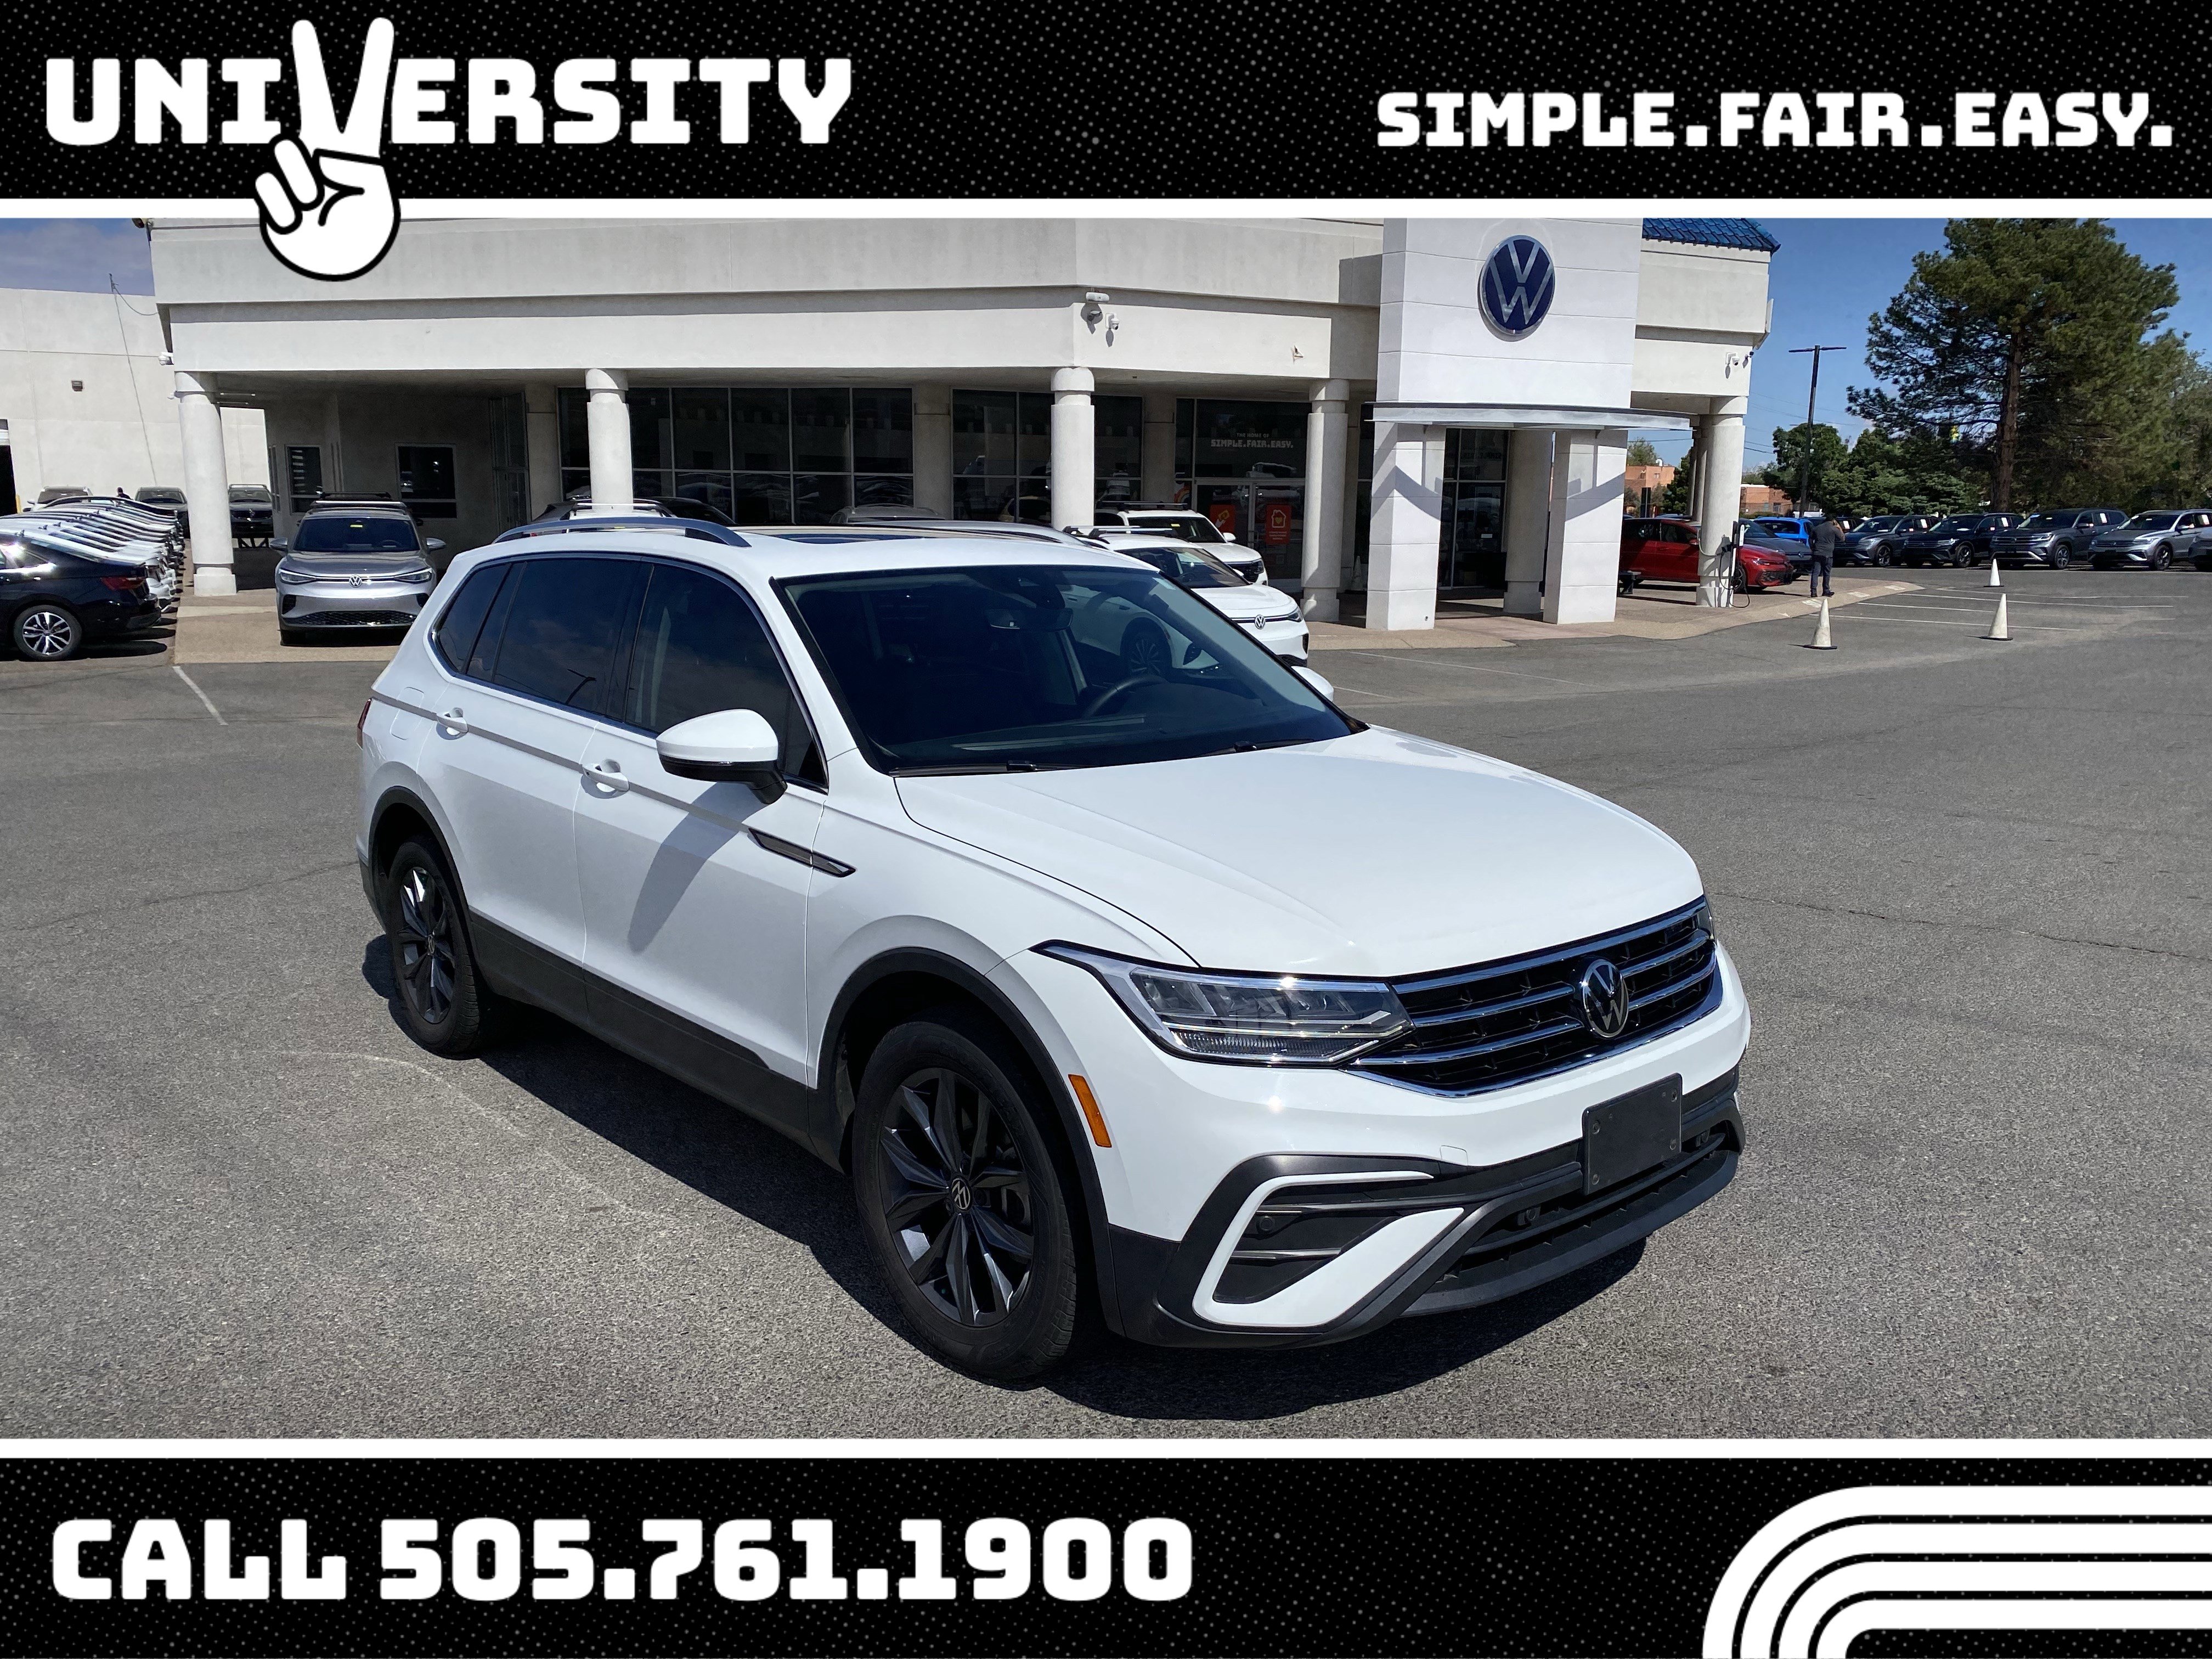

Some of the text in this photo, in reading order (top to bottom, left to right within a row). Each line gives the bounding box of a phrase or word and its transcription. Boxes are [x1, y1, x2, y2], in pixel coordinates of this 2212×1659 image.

[1486, 237, 1555, 329] VW
[1210, 439, 1294, 448] SIMPLE.FAIR.EASY.
[349, 574, 362, 588] VW
[1255, 615, 1265, 628] VW
[1583, 960, 1628, 1035] VW
